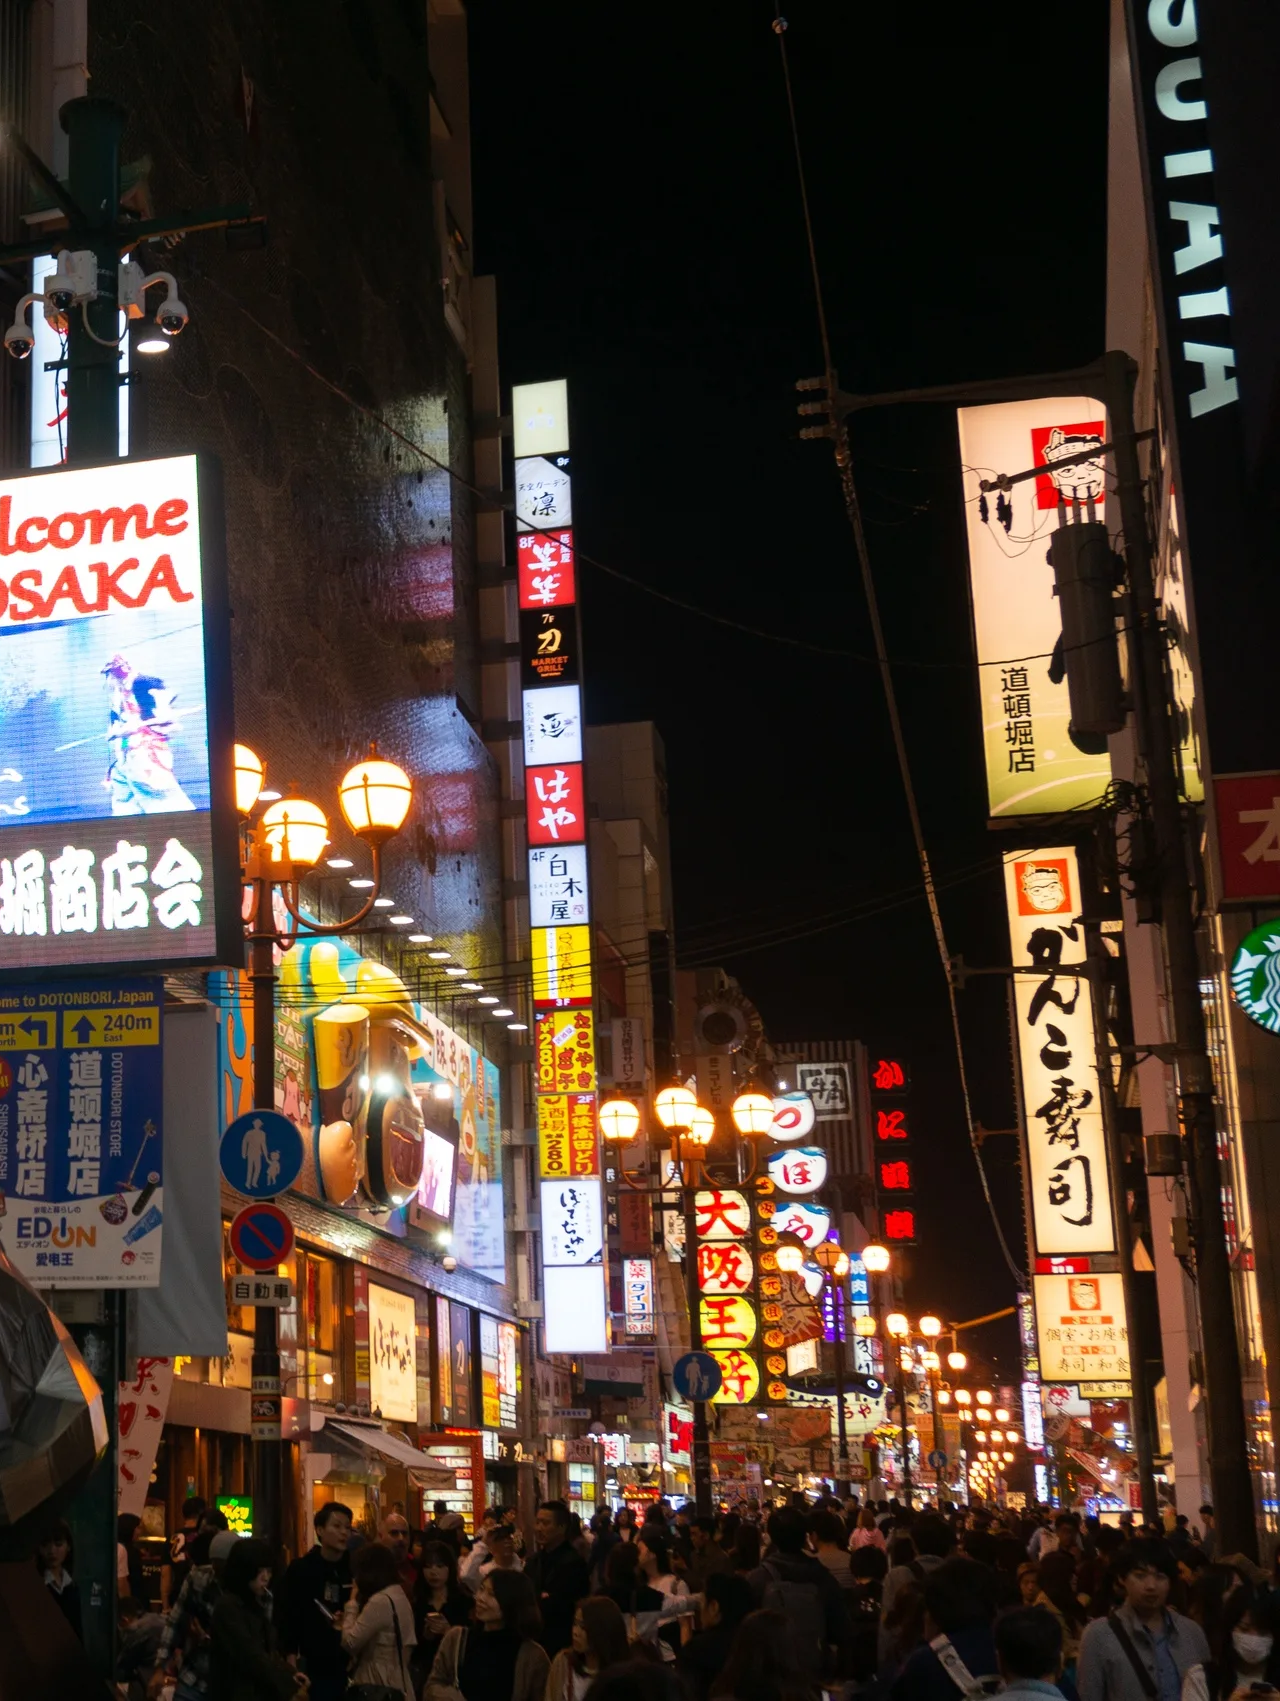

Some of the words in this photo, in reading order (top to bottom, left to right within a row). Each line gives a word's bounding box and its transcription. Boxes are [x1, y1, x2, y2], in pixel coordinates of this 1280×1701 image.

[519, 536, 535, 549] 8F
[542, 613, 555, 624] 7F
[531, 655, 569, 667] MARKET
[536, 664, 564, 674] GRILL
[1000, 666, 1036, 775] 道頓堀店
[534, 769, 577, 839] はや
[531, 851, 545, 862] 4F
[550, 853, 583, 920] 白木屋
[23, 994, 36, 1007] to
[39, 991, 116, 1006] DOTONBORI,
[118, 990, 154, 1005] Japan
[556, 998, 571, 1007] 3F
[103, 1014, 153, 1032] 240m
[103, 1033, 123, 1042] East
[574, 1011, 594, 1089] たこやき
[110, 1052, 124, 1118] DOTONBORI
[577, 1095, 595, 1104] 2F
[67, 1050, 103, 1196] 道顿堀店
[109, 1119, 122, 1157] STORE
[547, 1139, 563, 1171] 280
[33, 1206, 81, 1214] 家電と暮らしの
[16, 1217, 97, 1249] EDION
[16, 1241, 50, 1249] エディオン
[234, 1281, 289, 1300] 自動車
[696, 1191, 752, 1404] 大阪王将
